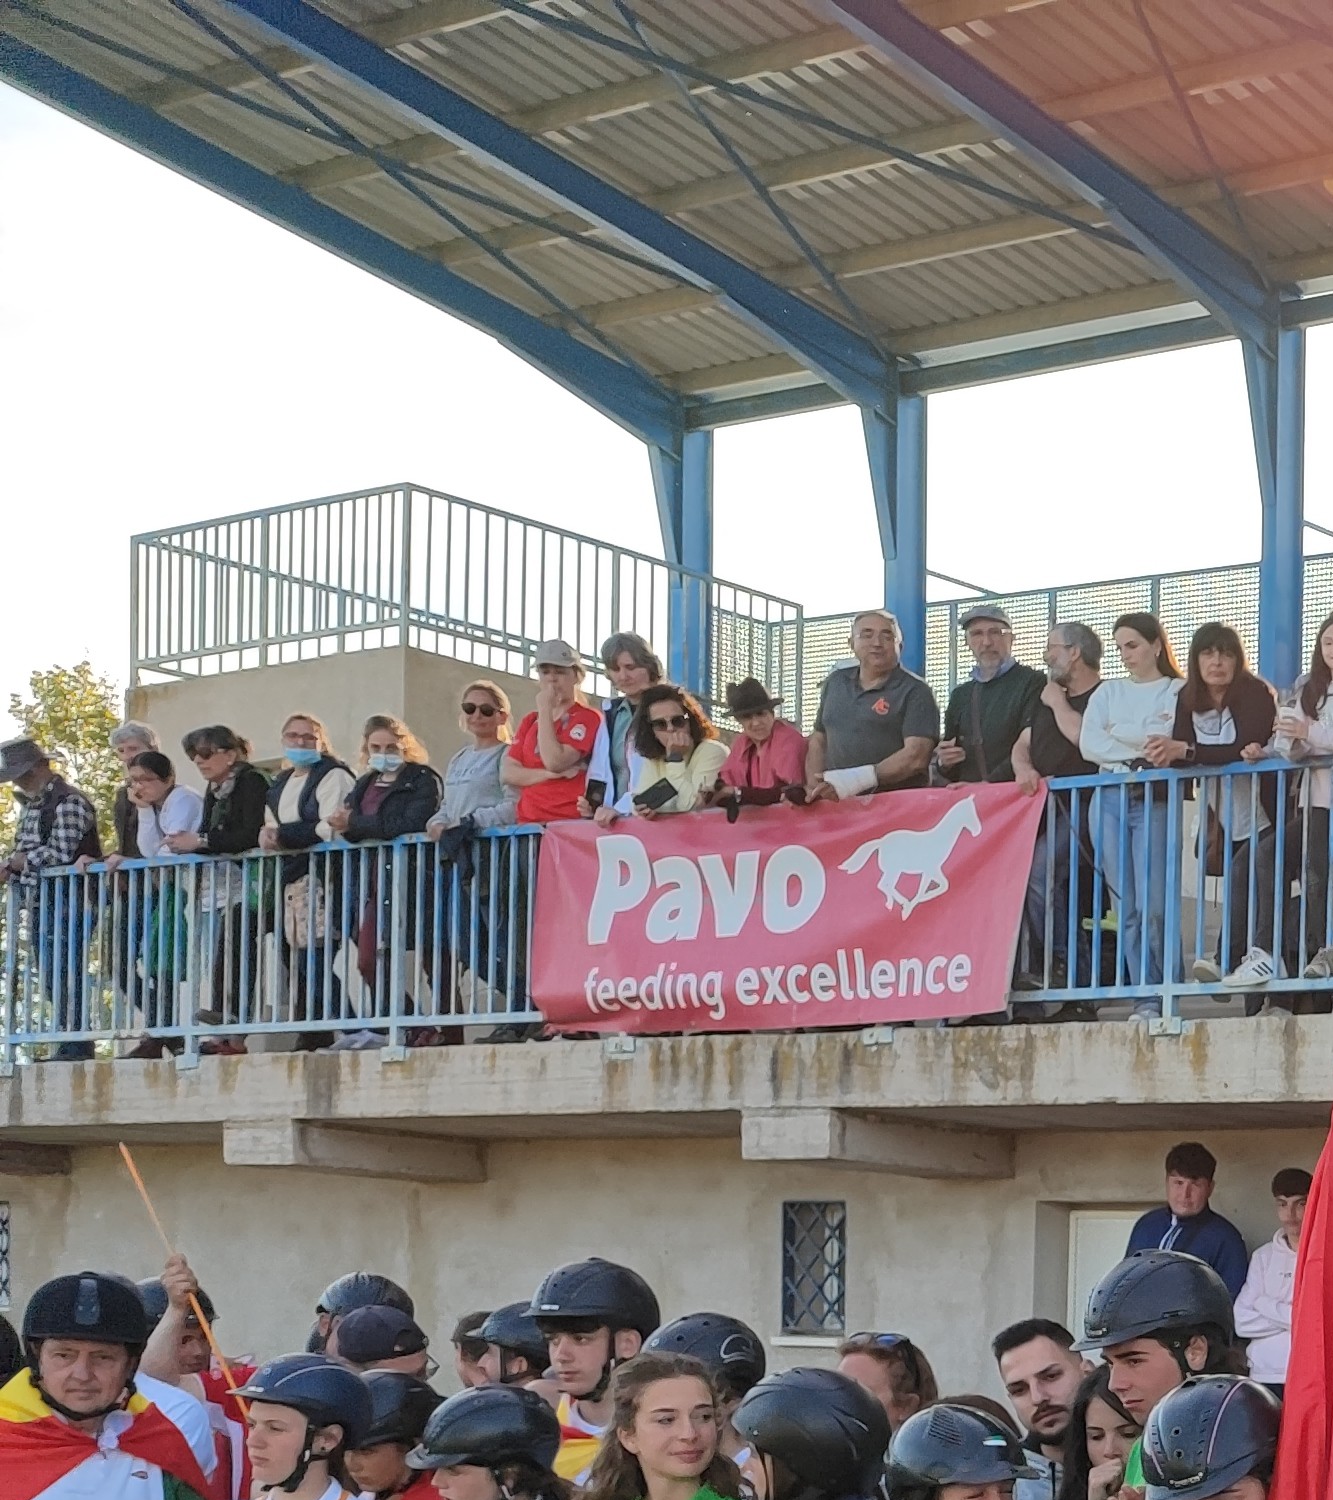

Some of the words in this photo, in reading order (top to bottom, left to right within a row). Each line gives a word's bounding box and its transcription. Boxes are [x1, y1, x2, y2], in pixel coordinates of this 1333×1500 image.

[587, 834, 826, 945] Pavo
[584, 961, 722, 1021] feeding
[735, 947, 971, 1006] excellence
